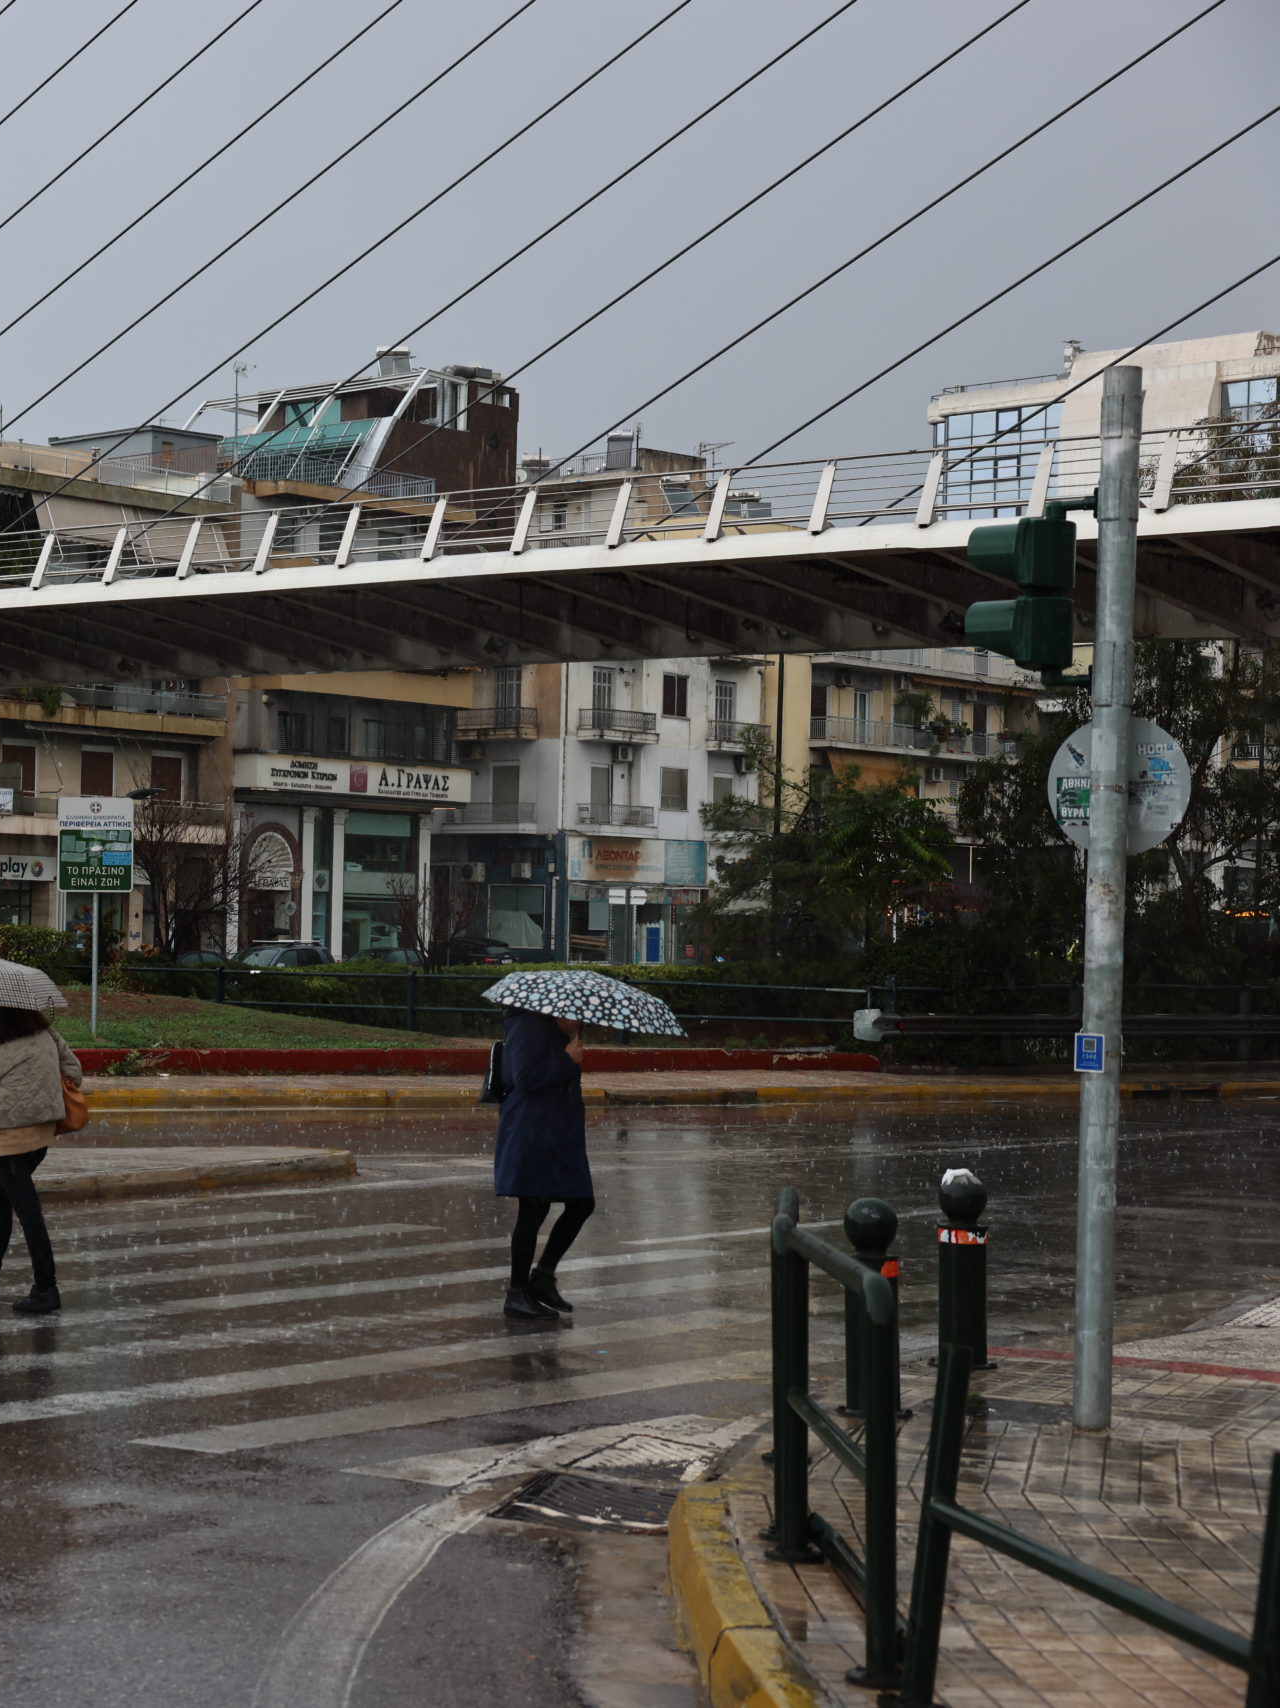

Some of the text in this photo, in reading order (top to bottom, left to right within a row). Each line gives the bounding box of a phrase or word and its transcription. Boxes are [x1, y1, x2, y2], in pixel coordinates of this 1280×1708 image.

[0, 856, 28, 878] play
[67, 866, 125, 875] ΤΟ ΠΡΑΣΙΝΟ
[71, 878, 120, 886] ΕΙΝΑΙ ΖΩΗ
